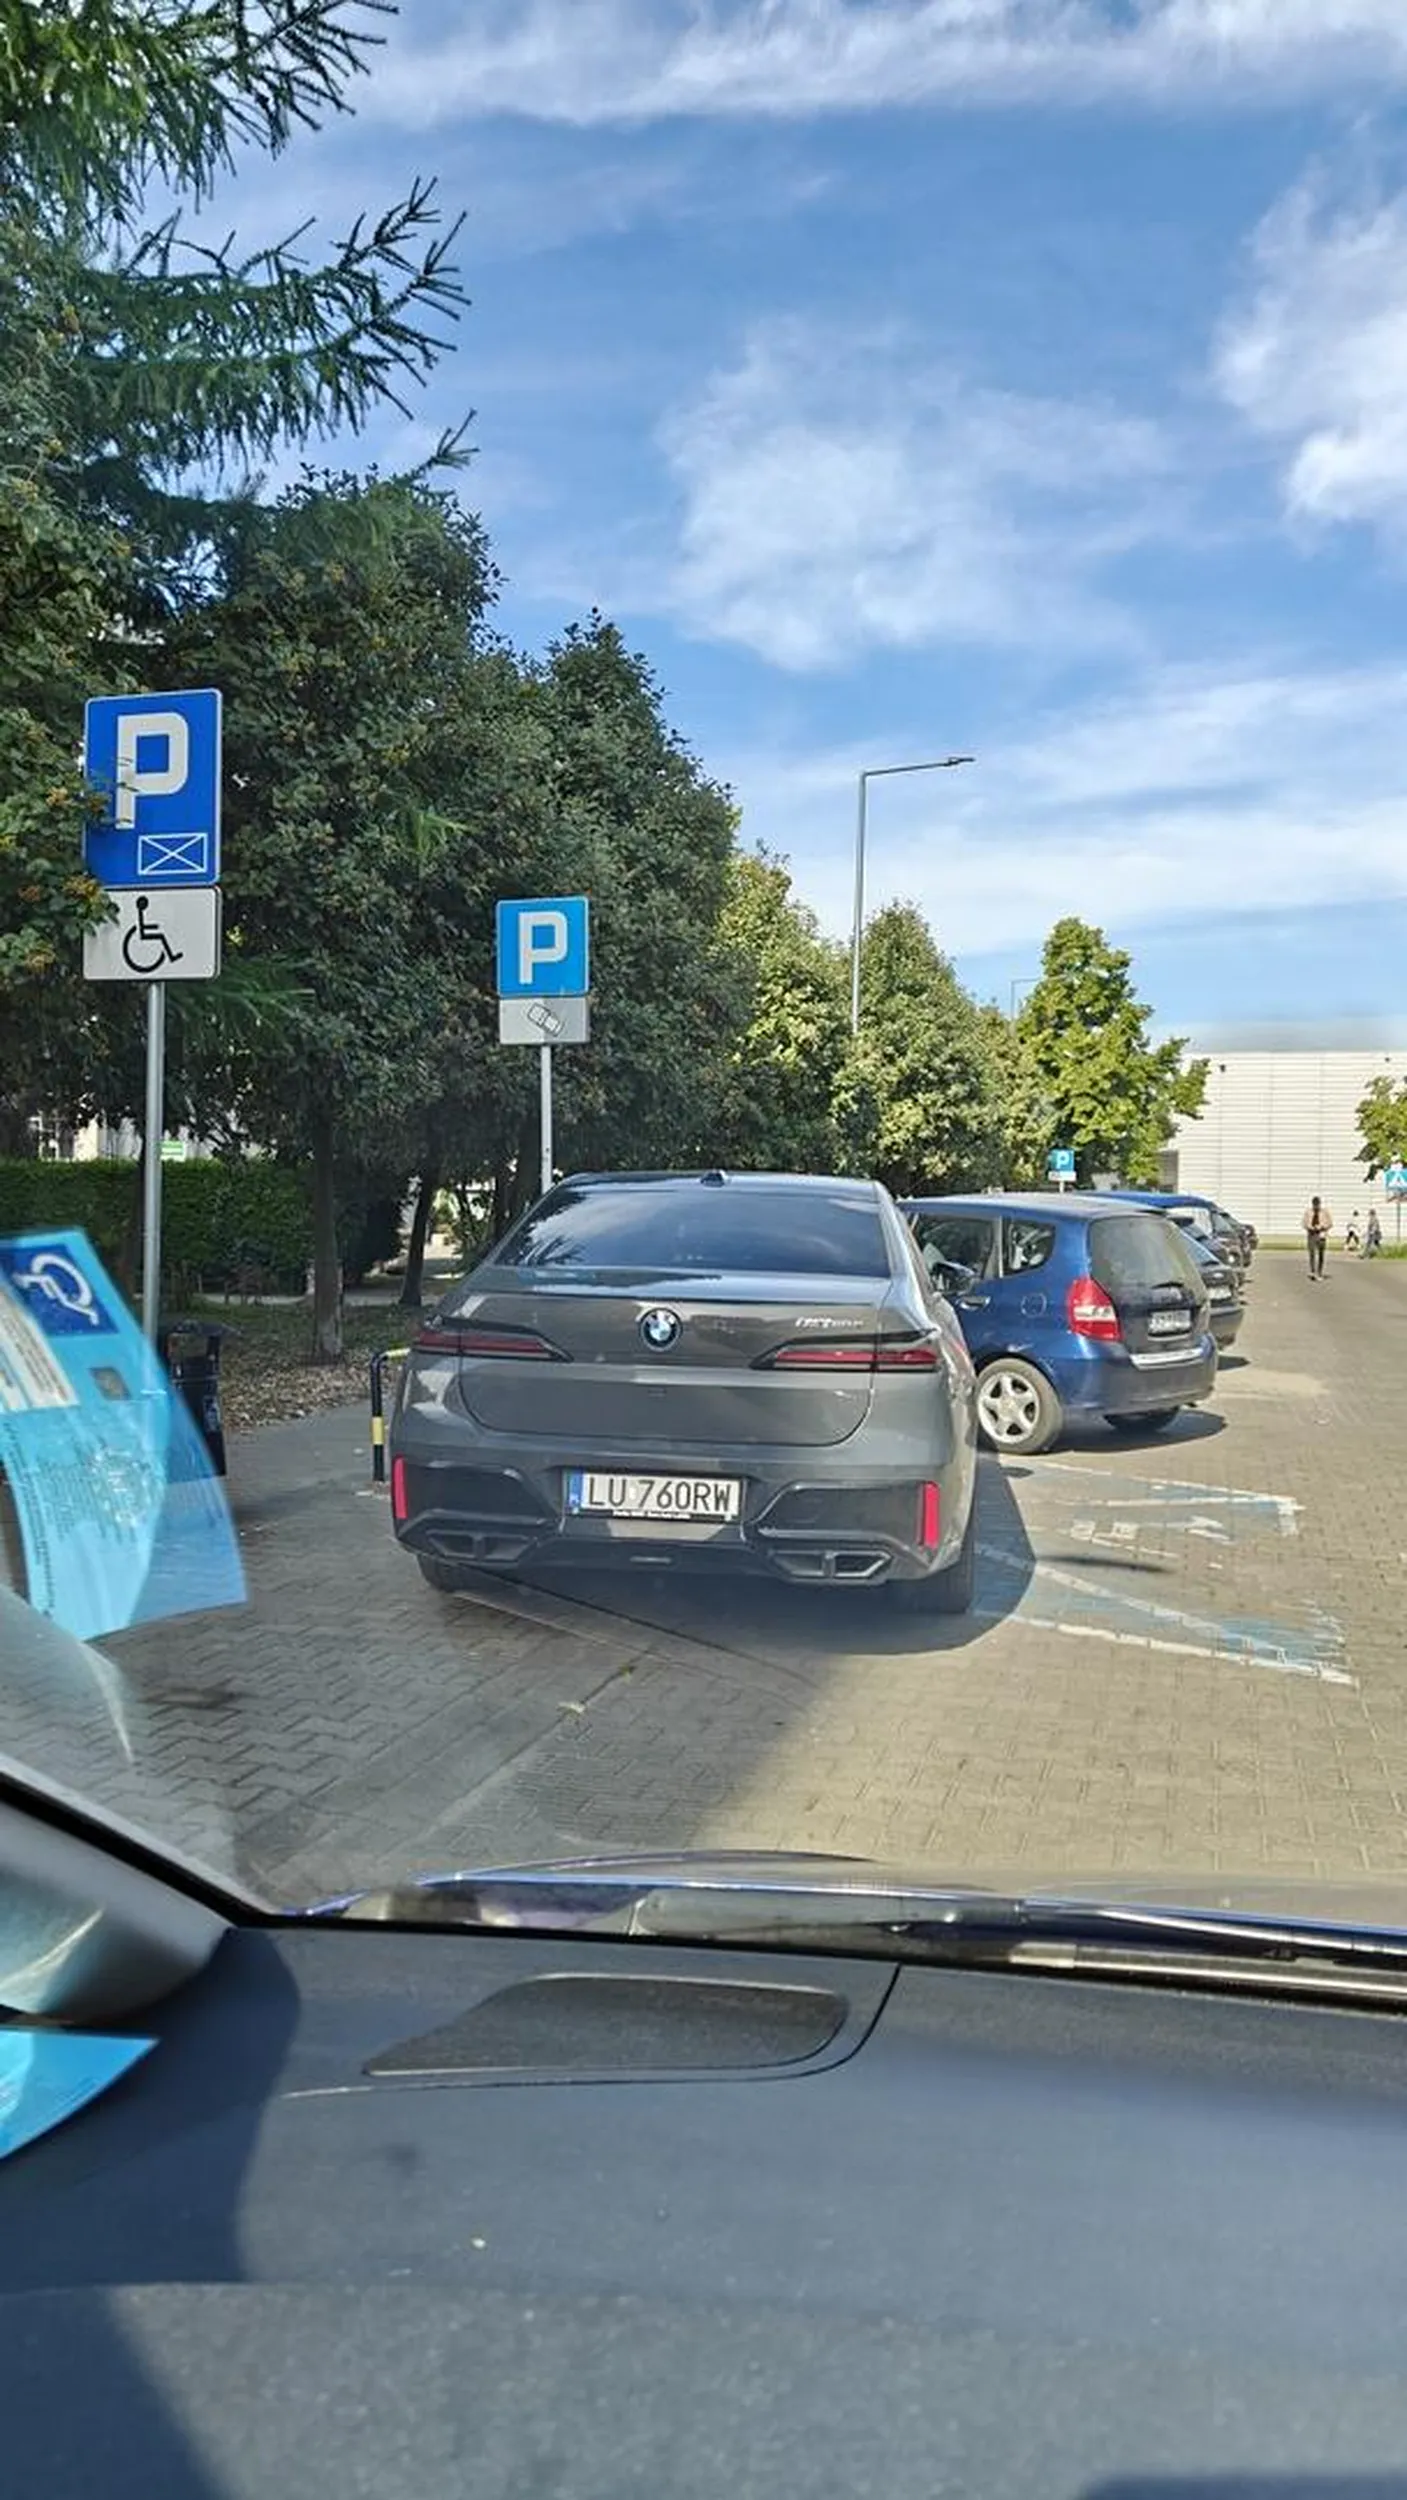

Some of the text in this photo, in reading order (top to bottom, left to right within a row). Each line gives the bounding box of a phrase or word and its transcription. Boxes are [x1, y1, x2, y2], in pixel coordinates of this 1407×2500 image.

[115, 712, 189, 830] P
[518, 911, 568, 985] P
[1056, 1150, 1070, 1170] P
[588, 1477, 731, 1512] LU 760RW
